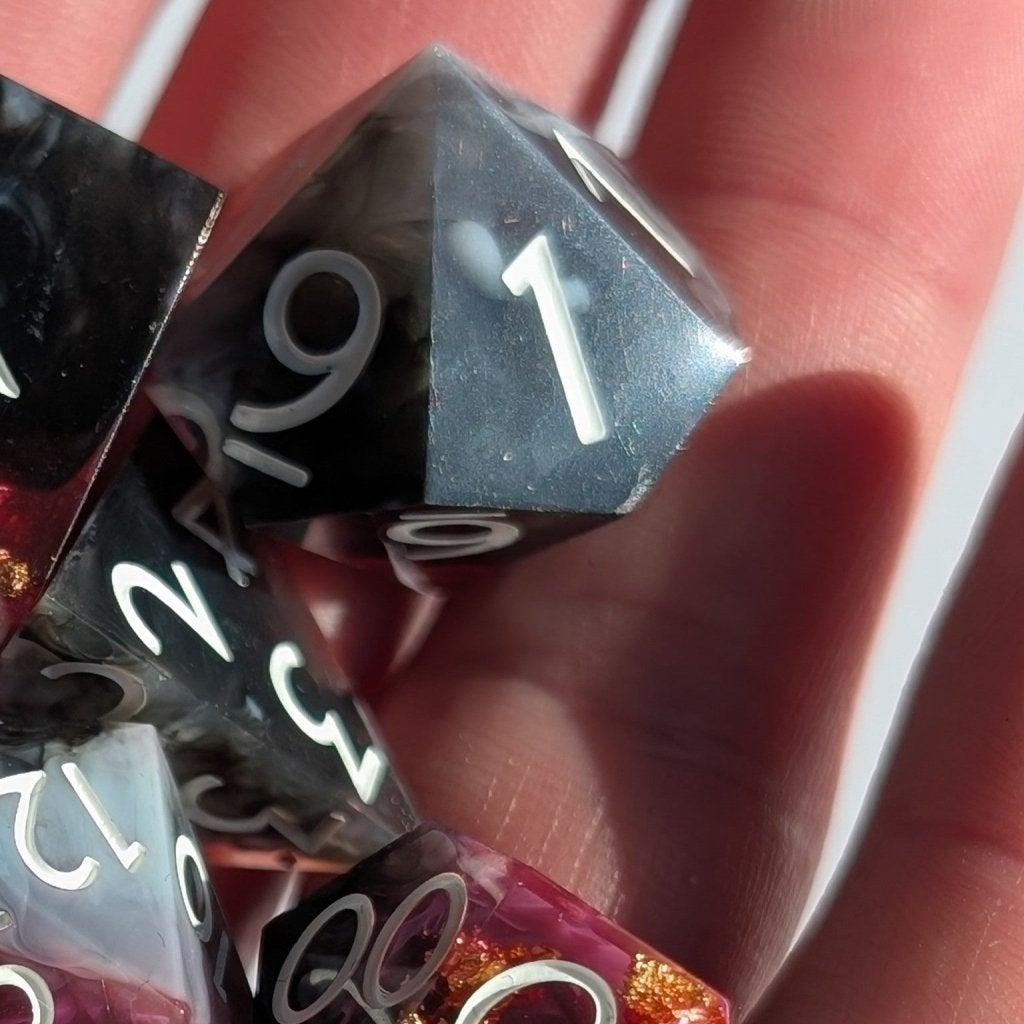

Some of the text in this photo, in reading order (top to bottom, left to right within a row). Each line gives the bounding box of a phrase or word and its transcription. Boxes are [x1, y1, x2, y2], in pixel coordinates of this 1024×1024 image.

[222, 248, 382, 488] 9
[501, 233, 608, 445] 1
[111, 561, 235, 662] 2
[270, 641, 388, 804] 3
